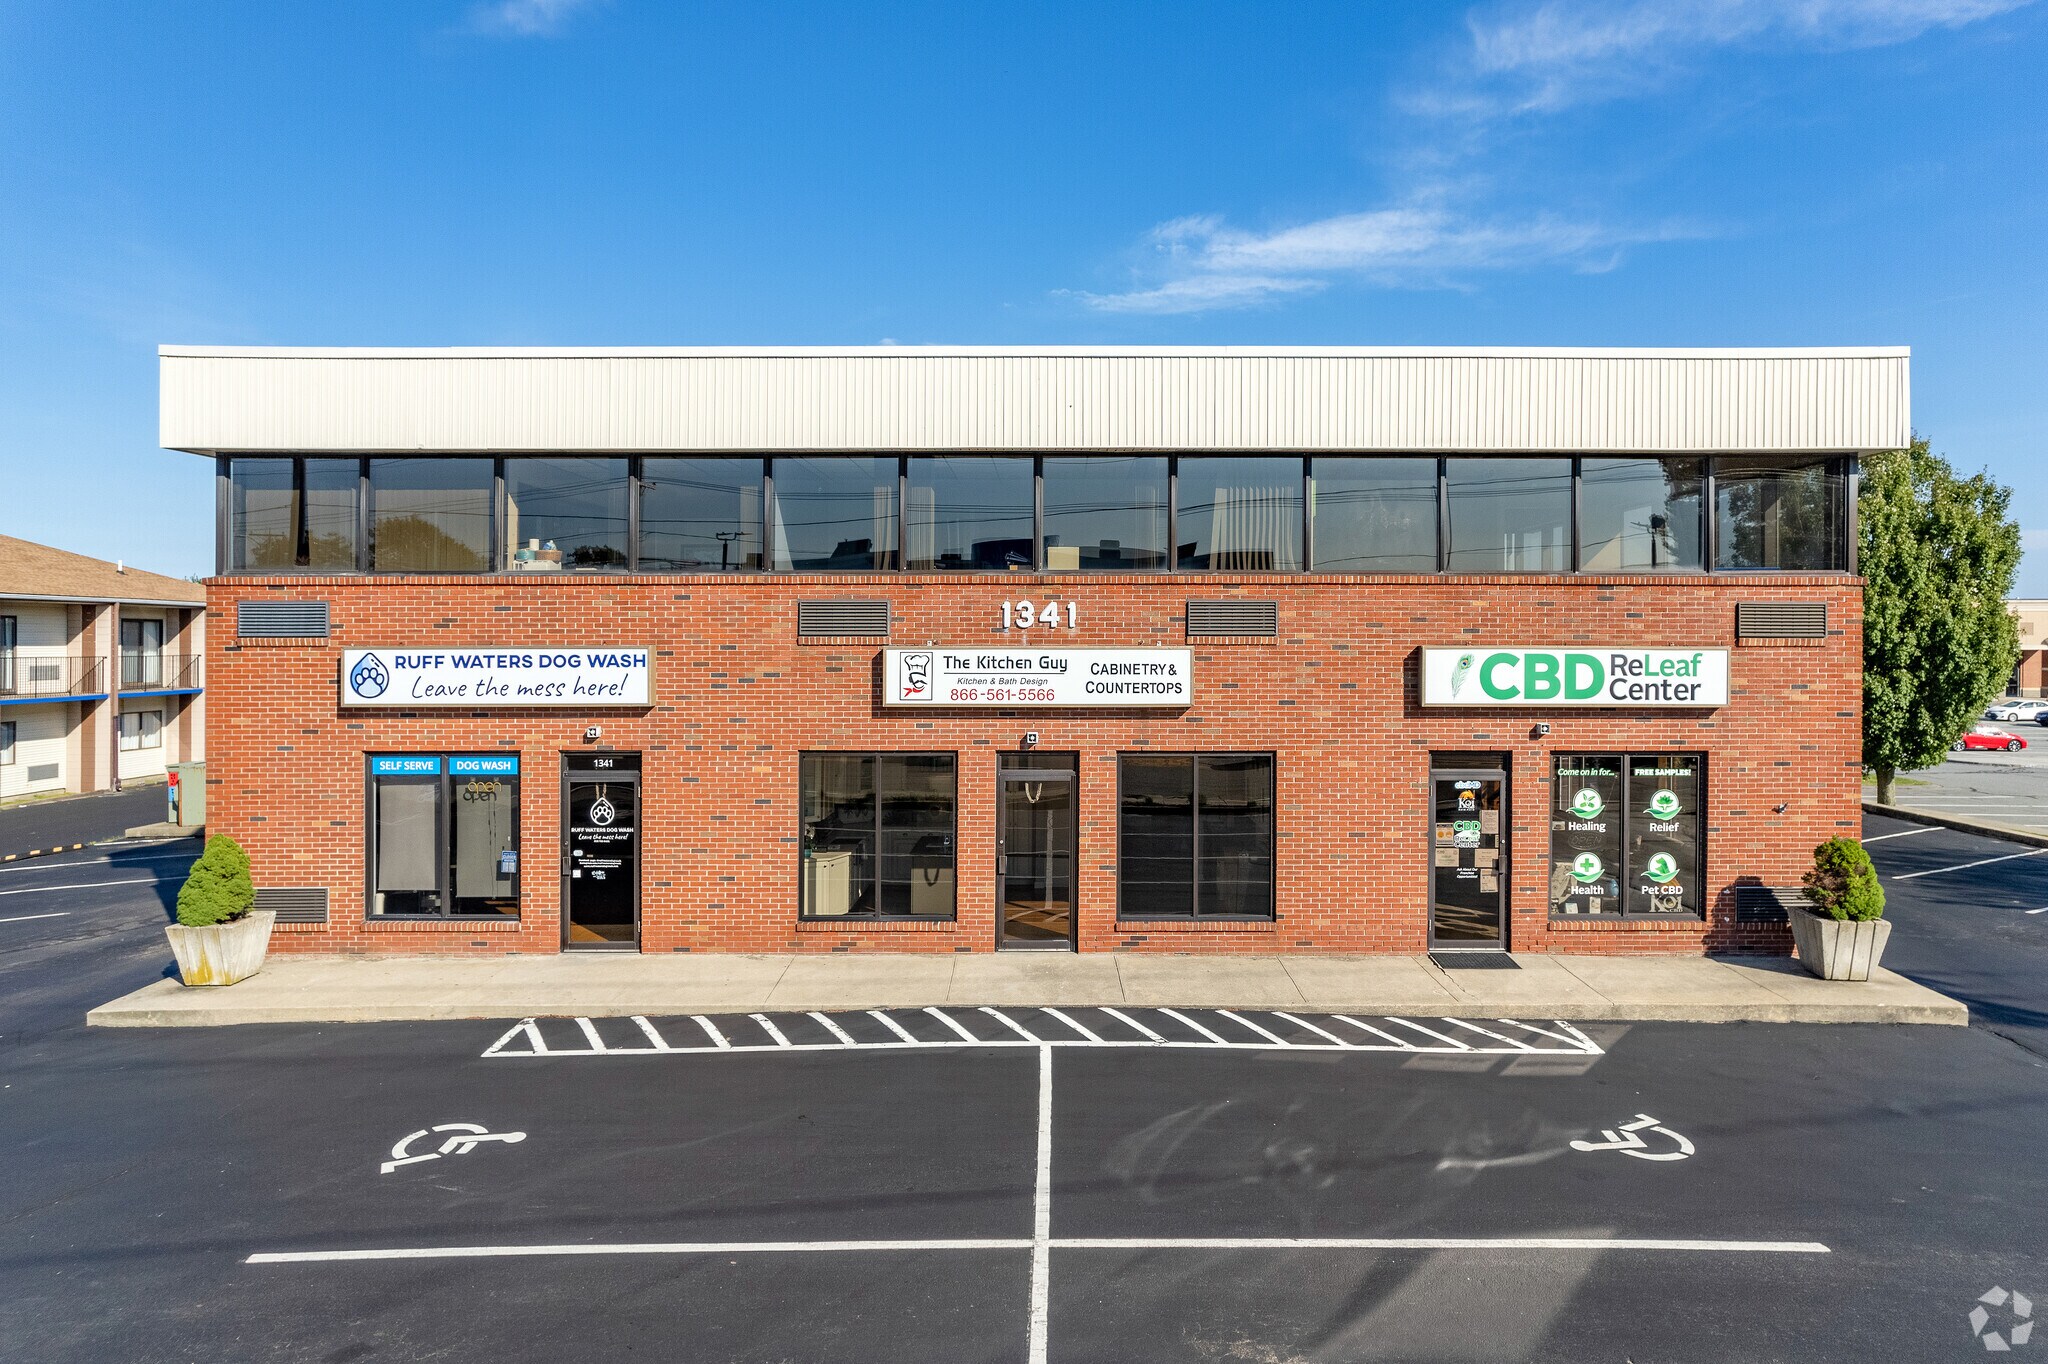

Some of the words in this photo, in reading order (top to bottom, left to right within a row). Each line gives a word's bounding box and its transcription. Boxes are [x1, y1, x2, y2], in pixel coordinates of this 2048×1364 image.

[1001, 601, 1077, 629] 1341
[395, 655, 445, 669] RUFF
[451, 654, 533, 668] WATERS
[539, 654, 581, 668] DOG
[587, 654, 647, 668] WASH
[943, 656, 970, 669] The
[977, 655, 1032, 669] Kitchen
[1039, 656, 1068, 672] Guy
[1610, 653, 1703, 677] ReLeaf
[957, 677, 988, 685] Kitchen
[990, 677, 996, 685] &
[998, 677, 1017, 685] Bath
[1020, 677, 1048, 687] Design
[1479, 653, 1605, 700] CBD
[411, 675, 467, 698] Leave
[475, 676, 509, 697] the
[517, 681, 566, 697] mess
[573, 673, 629, 697] here!
[1085, 681, 1182, 694] COUNTERTOPS
[1609, 678, 1702, 701] Center
[950, 688, 1055, 701] 866-561-5566
[379, 761, 402, 770] SELF
[404, 761, 433, 770] SERVE
[457, 761, 479, 770] DOG
[481, 761, 510, 770] WASH
[593, 759, 613, 767] 1341
[1558, 768, 1579, 776] Come
[1591, 768, 1598, 776] in
[1634, 768, 1654, 776] FREE
[1655, 768, 1692, 776] SAMPLES!
[468, 782, 501, 794] open
[1454, 821, 1481, 831] CBD
[1568, 821, 1606, 833] Healing
[1650, 822, 1680, 832] Relief
[1571, 885, 1604, 895] Health
[1642, 885, 1659, 895] Pet
[1661, 885, 1683, 895] CBD
